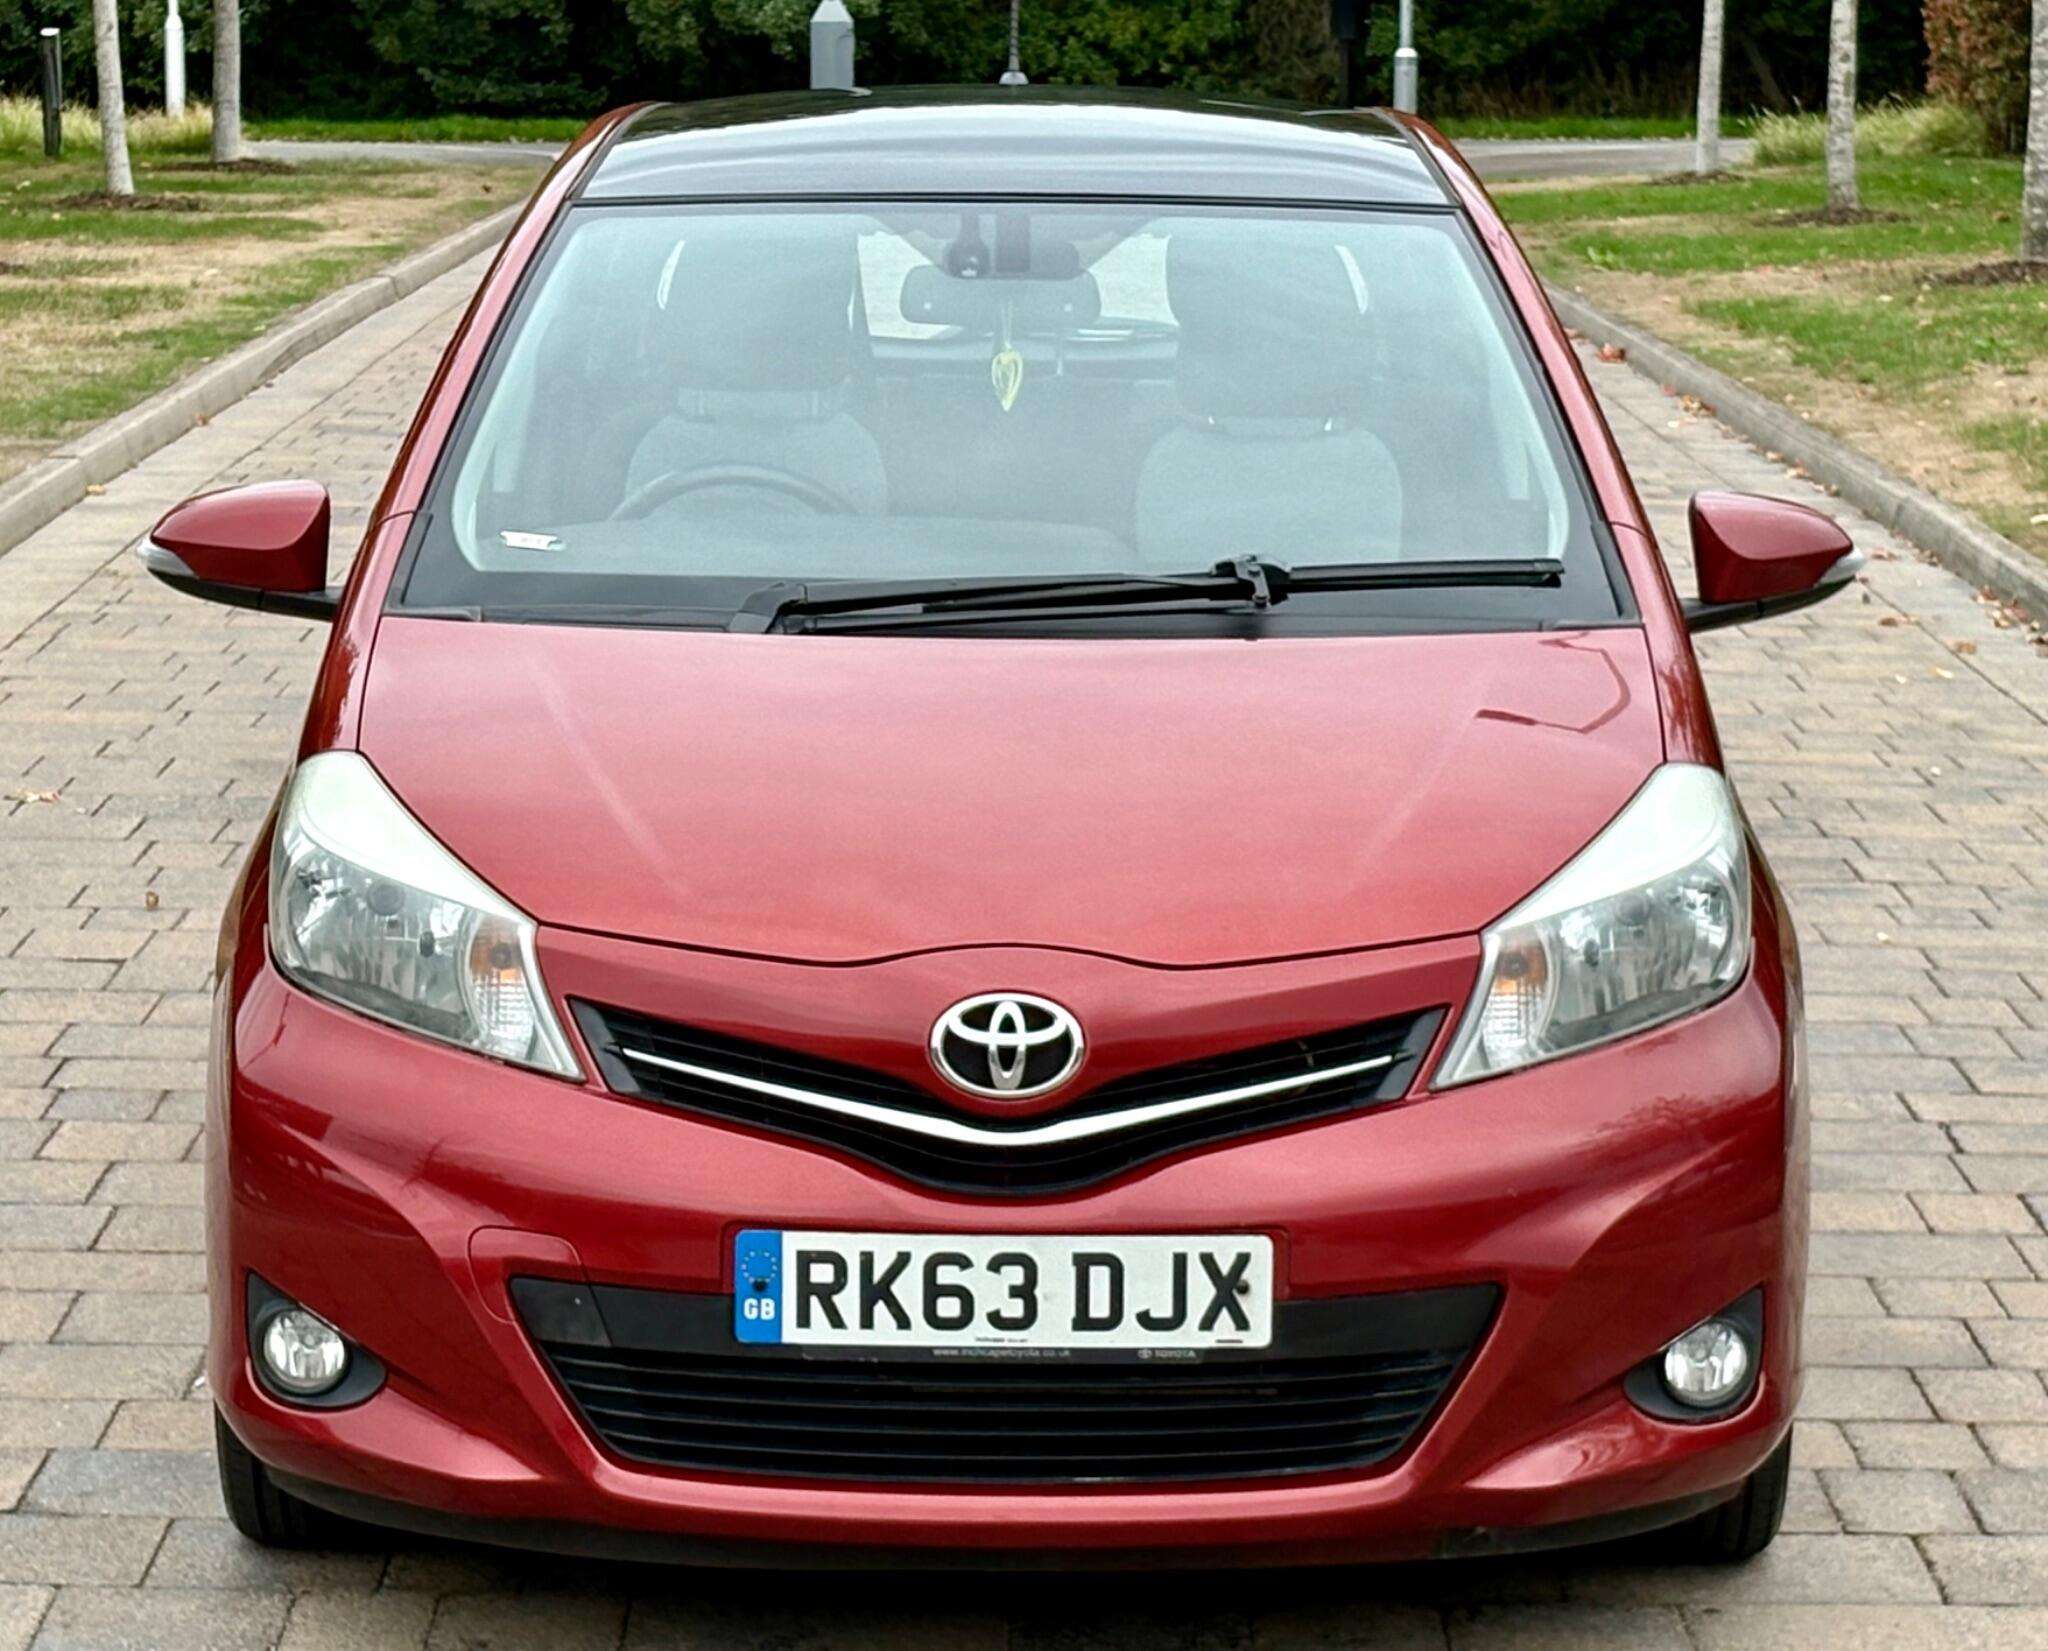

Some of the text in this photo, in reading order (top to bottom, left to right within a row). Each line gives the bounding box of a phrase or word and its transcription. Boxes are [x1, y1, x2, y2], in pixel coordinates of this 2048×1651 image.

[743, 1297, 776, 1321] GB
[796, 1250, 1251, 1331] RK63 DJX
